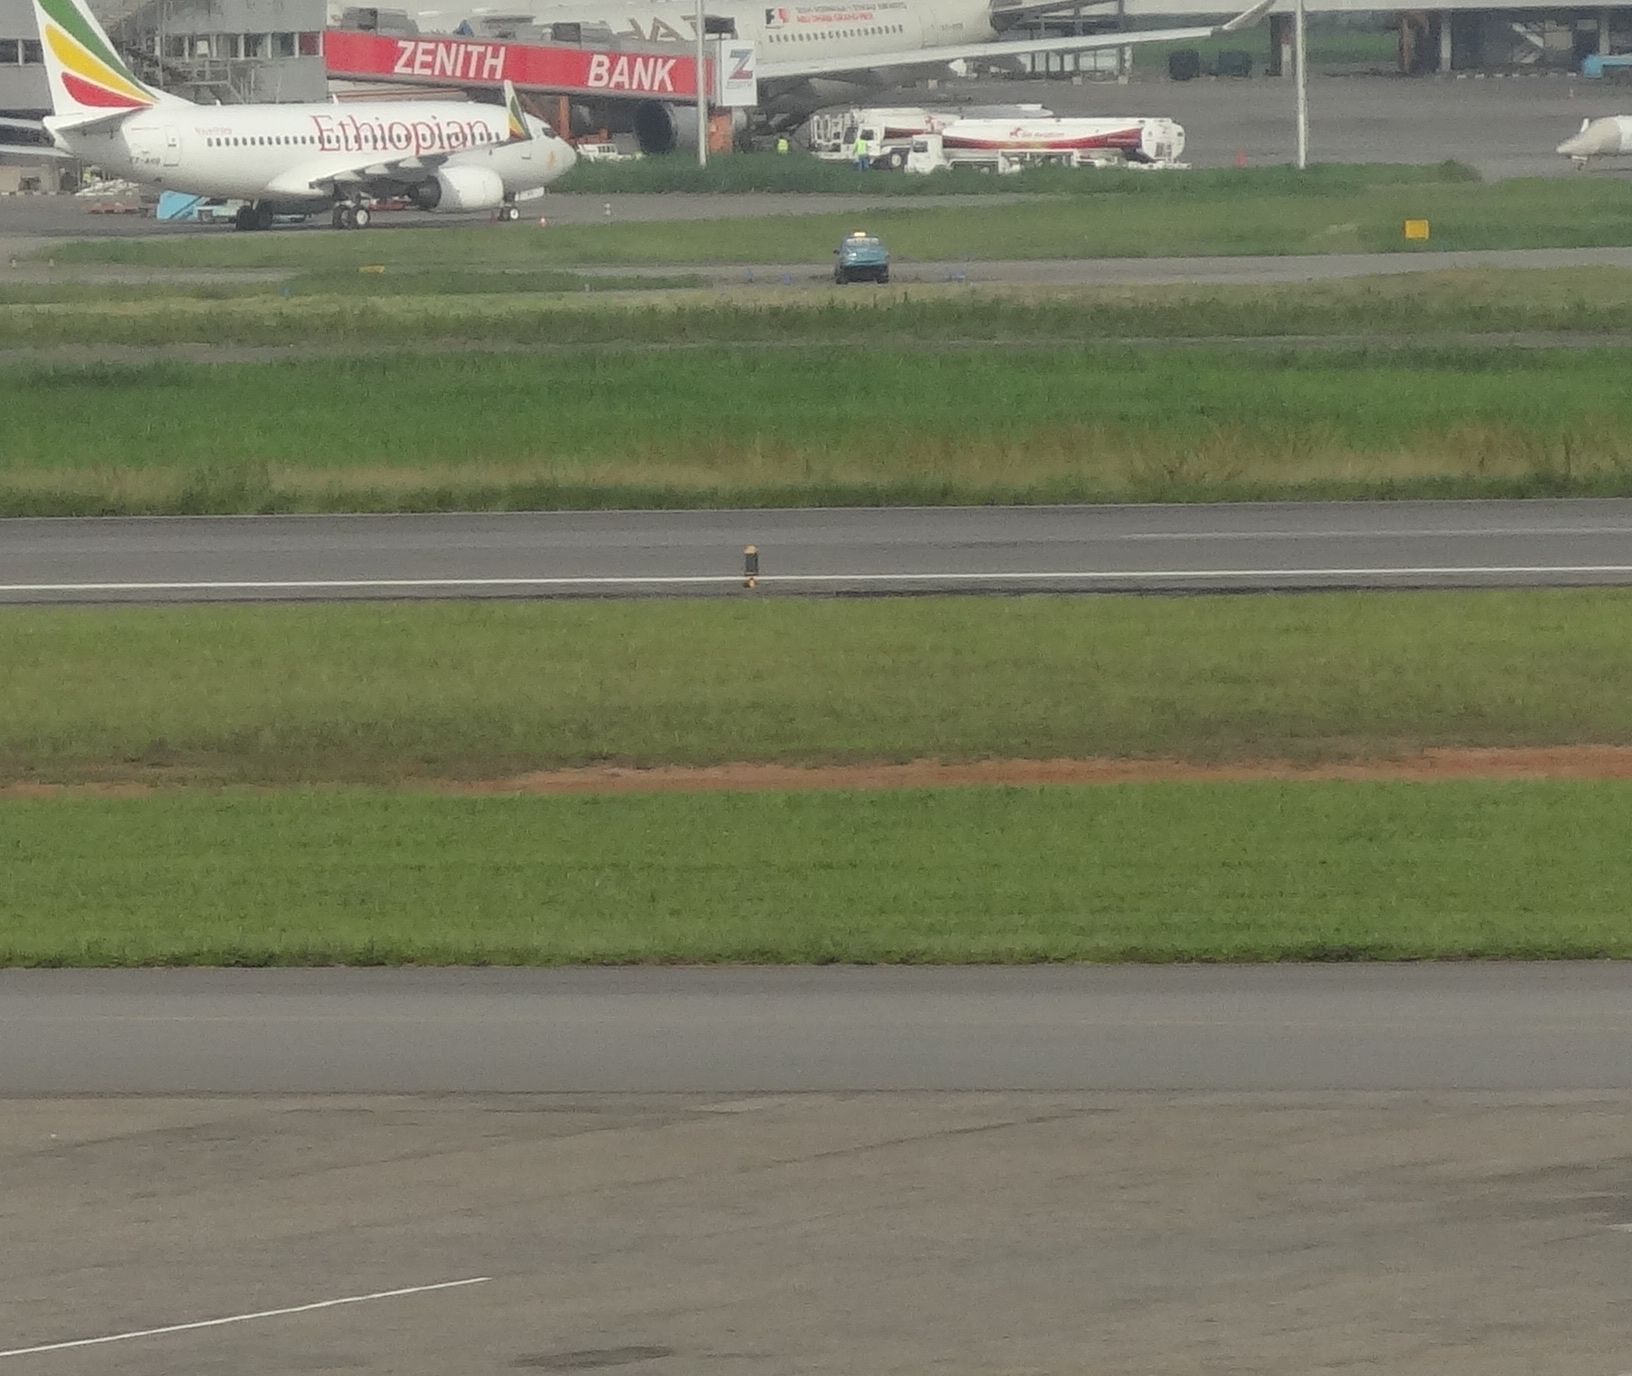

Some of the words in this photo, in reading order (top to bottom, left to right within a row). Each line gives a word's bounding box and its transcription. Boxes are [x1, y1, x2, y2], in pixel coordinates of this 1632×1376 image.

[393, 40, 506, 80] ZENITH
[587, 54, 676, 92] BANK
[311, 114, 490, 155] Ethiopian
